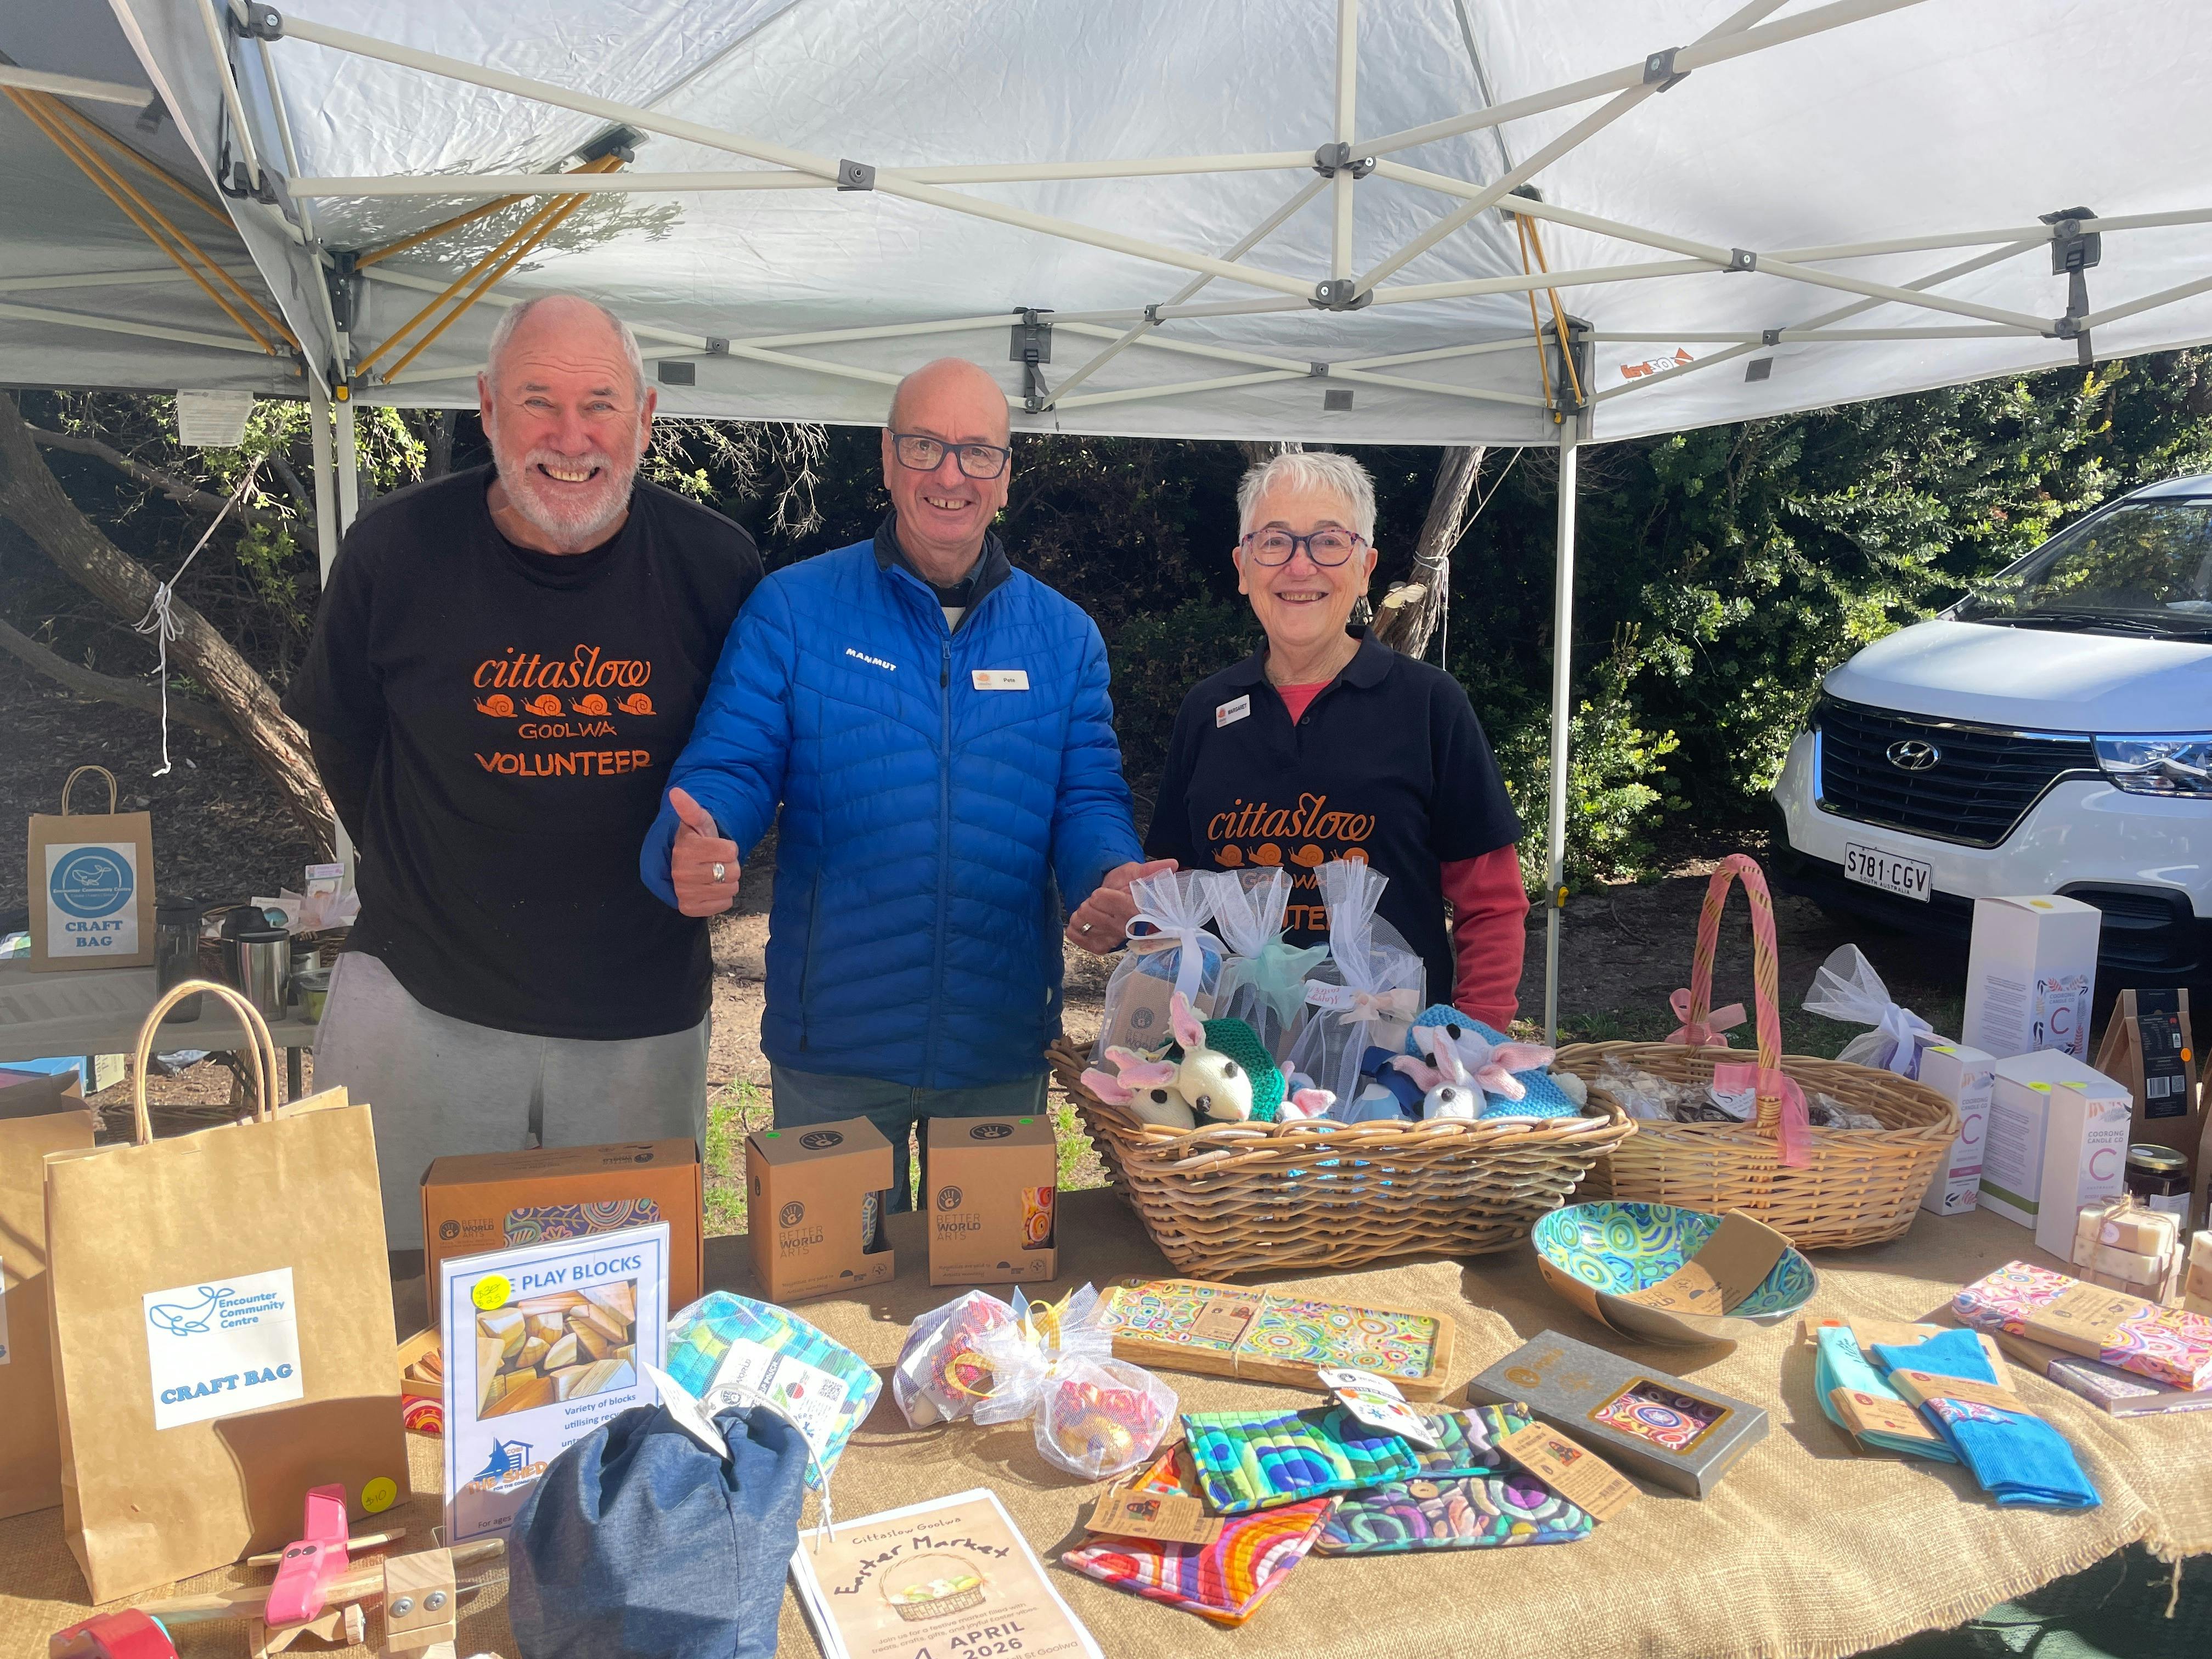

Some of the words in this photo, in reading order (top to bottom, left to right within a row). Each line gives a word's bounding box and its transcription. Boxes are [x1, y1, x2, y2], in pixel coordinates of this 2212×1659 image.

[474, 644, 651, 688] cittaslow
[845, 648, 896, 672] MAMMUT
[518, 721, 617, 739] GOOLWA
[475, 750, 653, 776] VOLUNTEER
[1208, 792, 1375, 842] cittaslow
[1860, 876, 1877, 885] SOUTH
[1880, 882, 1910, 895] AUSTRALIA
[65, 920, 123, 932] CRAFT
[76, 936, 112, 947] BAG
[2051, 1007, 2070, 1035] C
[1962, 1097, 1988, 1105] COORONG
[1961, 1114, 1982, 1144] C
[2089, 1148, 2117, 1181] C
[461, 1218, 494, 1227] BETTER
[936, 1214, 980, 1224] BETTER
[937, 1223, 981, 1232] WORLD
[779, 1226, 823, 1242] BETTER
[780, 1234, 823, 1249] WORLD
[936, 1231, 967, 1241] ARTS
[780, 1246, 809, 1259] ARTS
[522, 1269, 566, 1289] PLAY
[572, 1255, 641, 1280] BLOCKS
[219, 1292, 277, 1308] Encounter
[219, 1301, 285, 1318] Community
[220, 1316, 259, 1329] Centre
[161, 1374, 239, 1404] CRAFT
[244, 1364, 294, 1386] BAG
[565, 1403, 596, 1415] Variety
[598, 1399, 608, 1408] of
[609, 1394, 636, 1406] blocks
[565, 1417, 599, 1430] utilising
[466, 1477, 498, 1495] THE
[503, 1462, 548, 1483] SHED
[365, 1490, 386, 1506] $10
[494, 1515, 512, 1525] ages
[852, 1528, 913, 1545] Cittaslow
[917, 1516, 961, 1531] Goolwa
[929, 1621, 957, 1632] festive
[958, 1612, 987, 1623] market
[989, 1607, 1007, 1615] filled
[1009, 1602, 1026, 1610] with
[872, 1644, 899, 1654] treats,
[928, 1630, 947, 1640] gifts,
[949, 1625, 965, 1634] and
[967, 1619, 989, 1630] joyful
[990, 1612, 1015, 1622] Easter
[950, 1621, 1025, 1650] APRIL
[962, 1638, 1023, 1659] 2026
[1037, 1641, 1079, 1656] Goolwa
